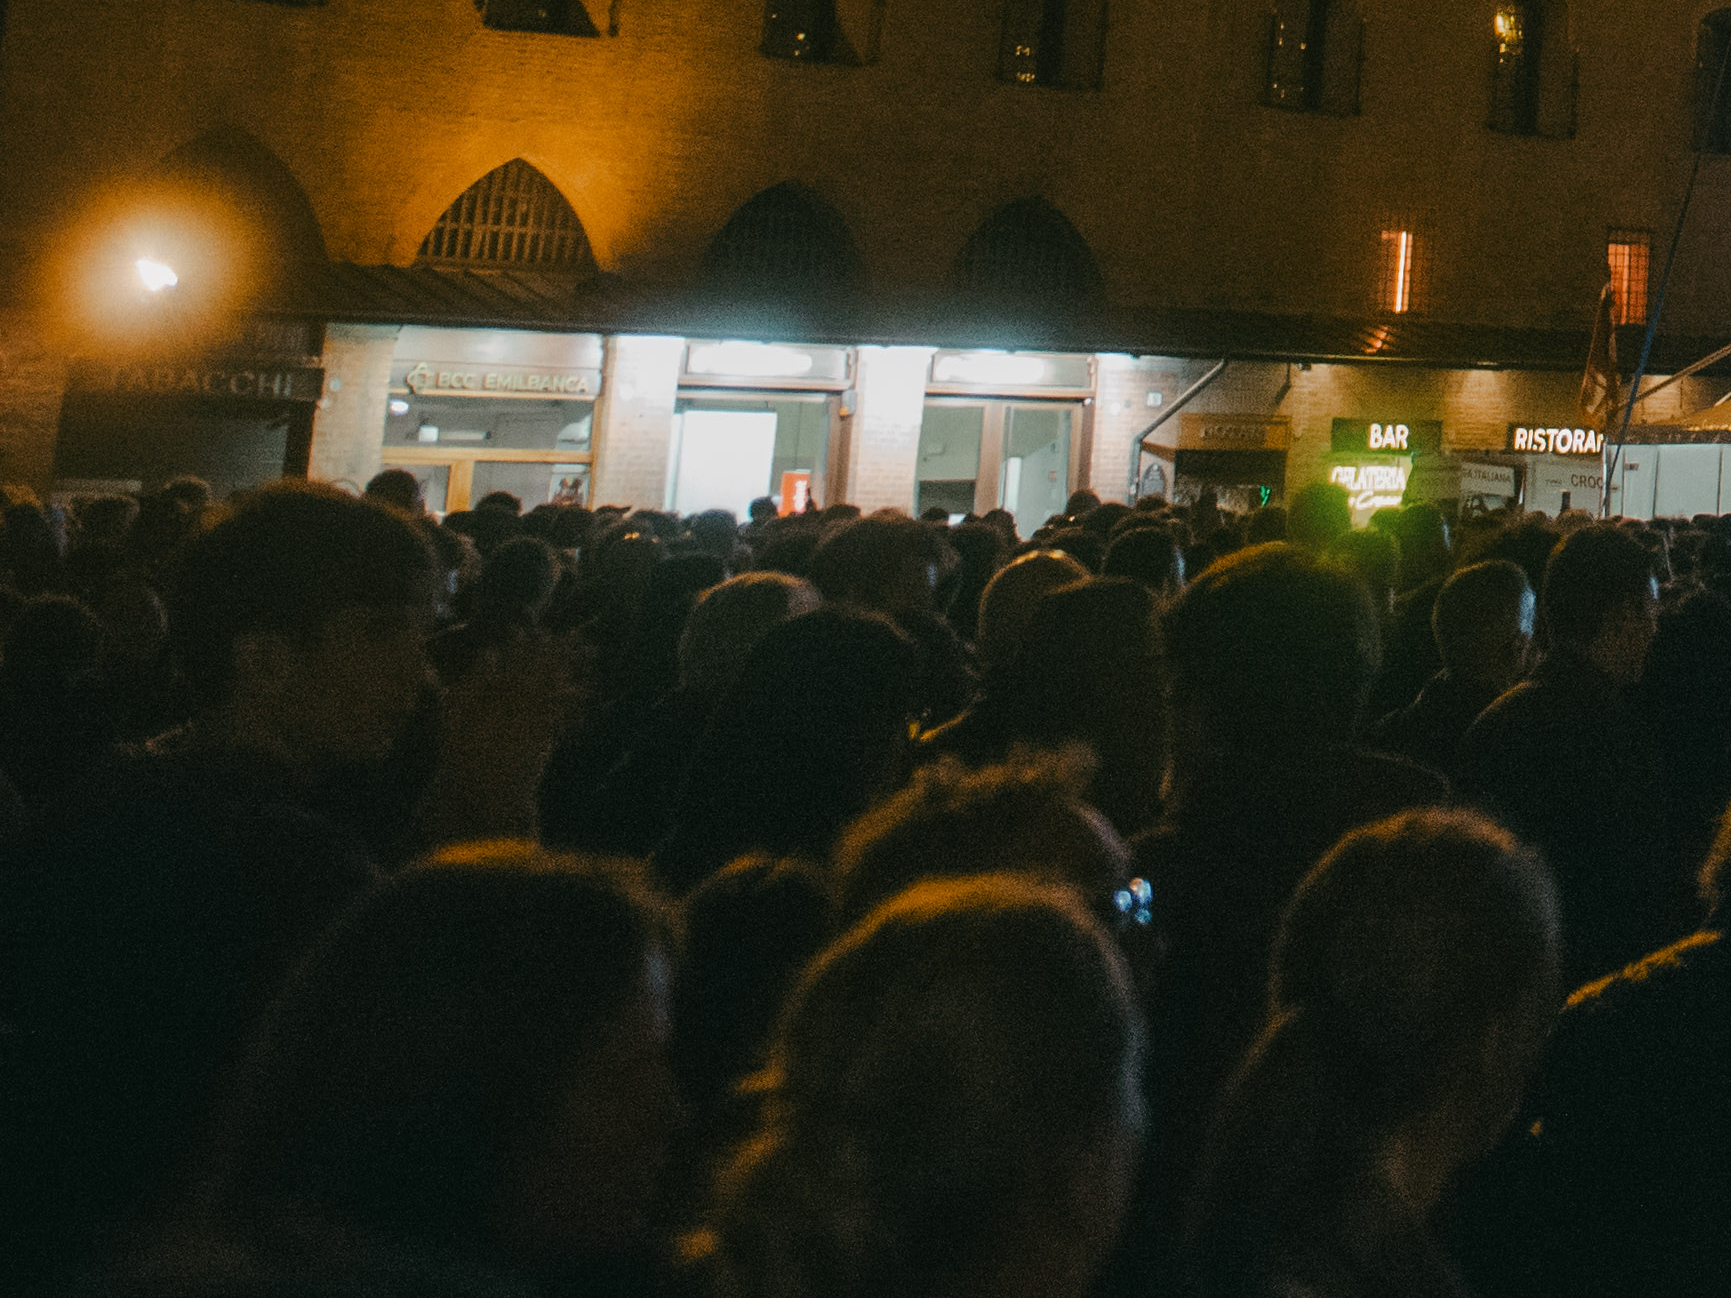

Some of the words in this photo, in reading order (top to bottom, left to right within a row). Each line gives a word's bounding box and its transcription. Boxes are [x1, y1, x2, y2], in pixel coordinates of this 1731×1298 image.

[110, 367, 293, 398] TABACCHI
[437, 371, 475, 389] BCC
[484, 373, 590, 394] EMILBANCA
[1368, 421, 1410, 451] BAR
